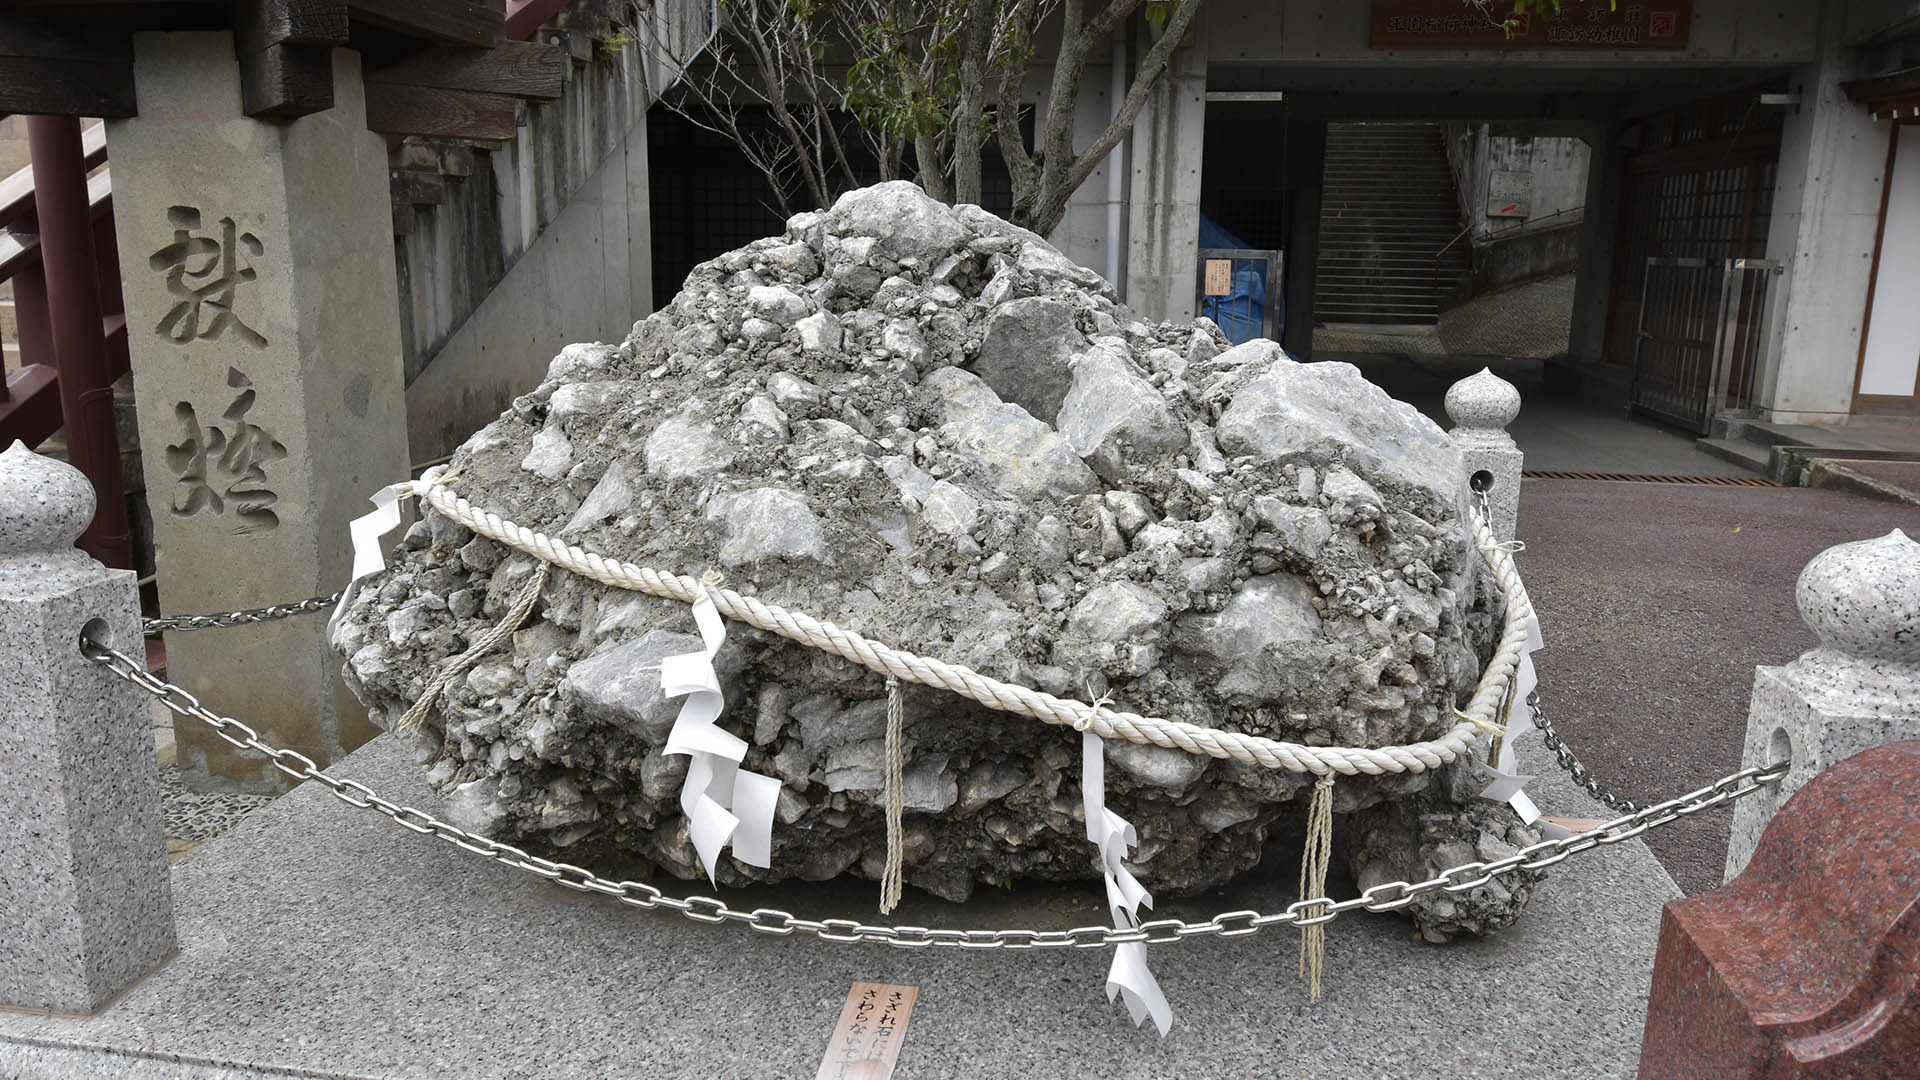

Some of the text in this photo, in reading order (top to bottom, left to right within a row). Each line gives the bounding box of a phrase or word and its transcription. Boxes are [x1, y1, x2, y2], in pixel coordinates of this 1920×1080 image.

[866, 991, 903, 1062] さざれ石には
